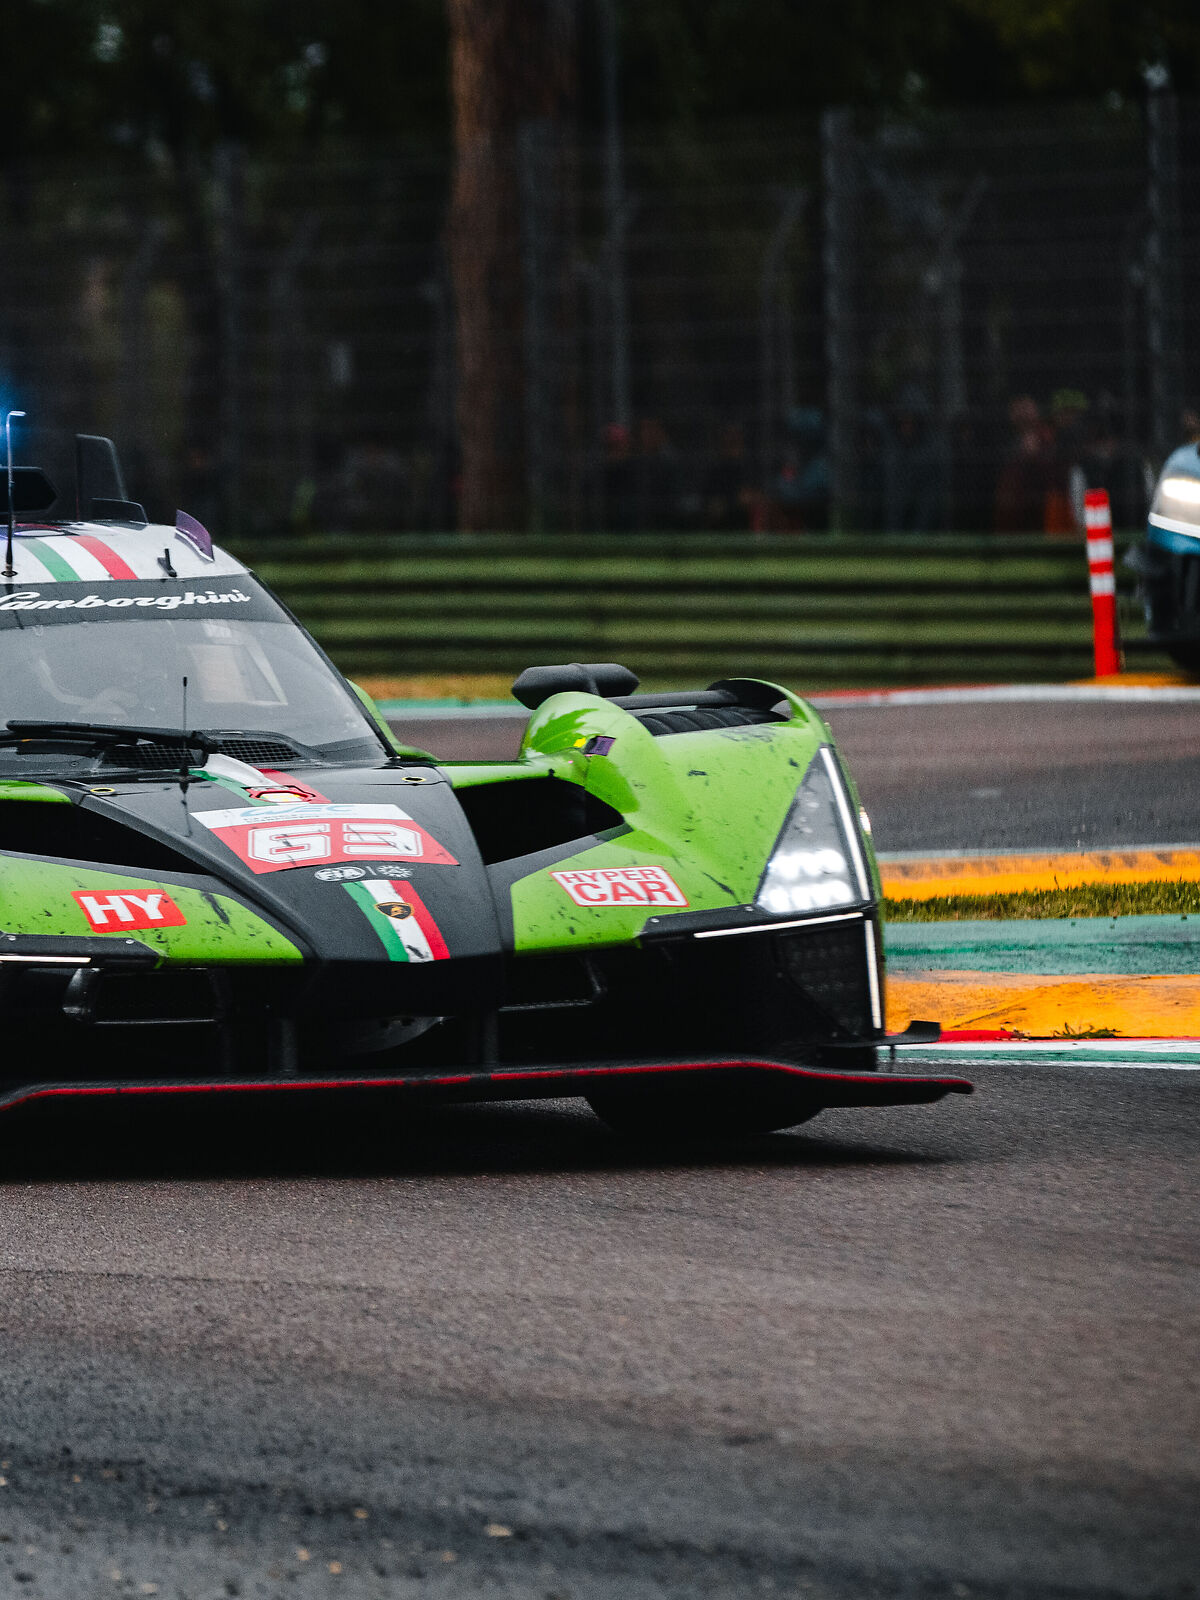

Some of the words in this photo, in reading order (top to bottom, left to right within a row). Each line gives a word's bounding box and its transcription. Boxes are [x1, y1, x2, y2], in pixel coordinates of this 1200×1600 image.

[247, 822, 424, 864] 63
[559, 868, 662, 884] HYPER
[572, 880, 678, 902] CAR
[79, 893, 166, 924] HY
